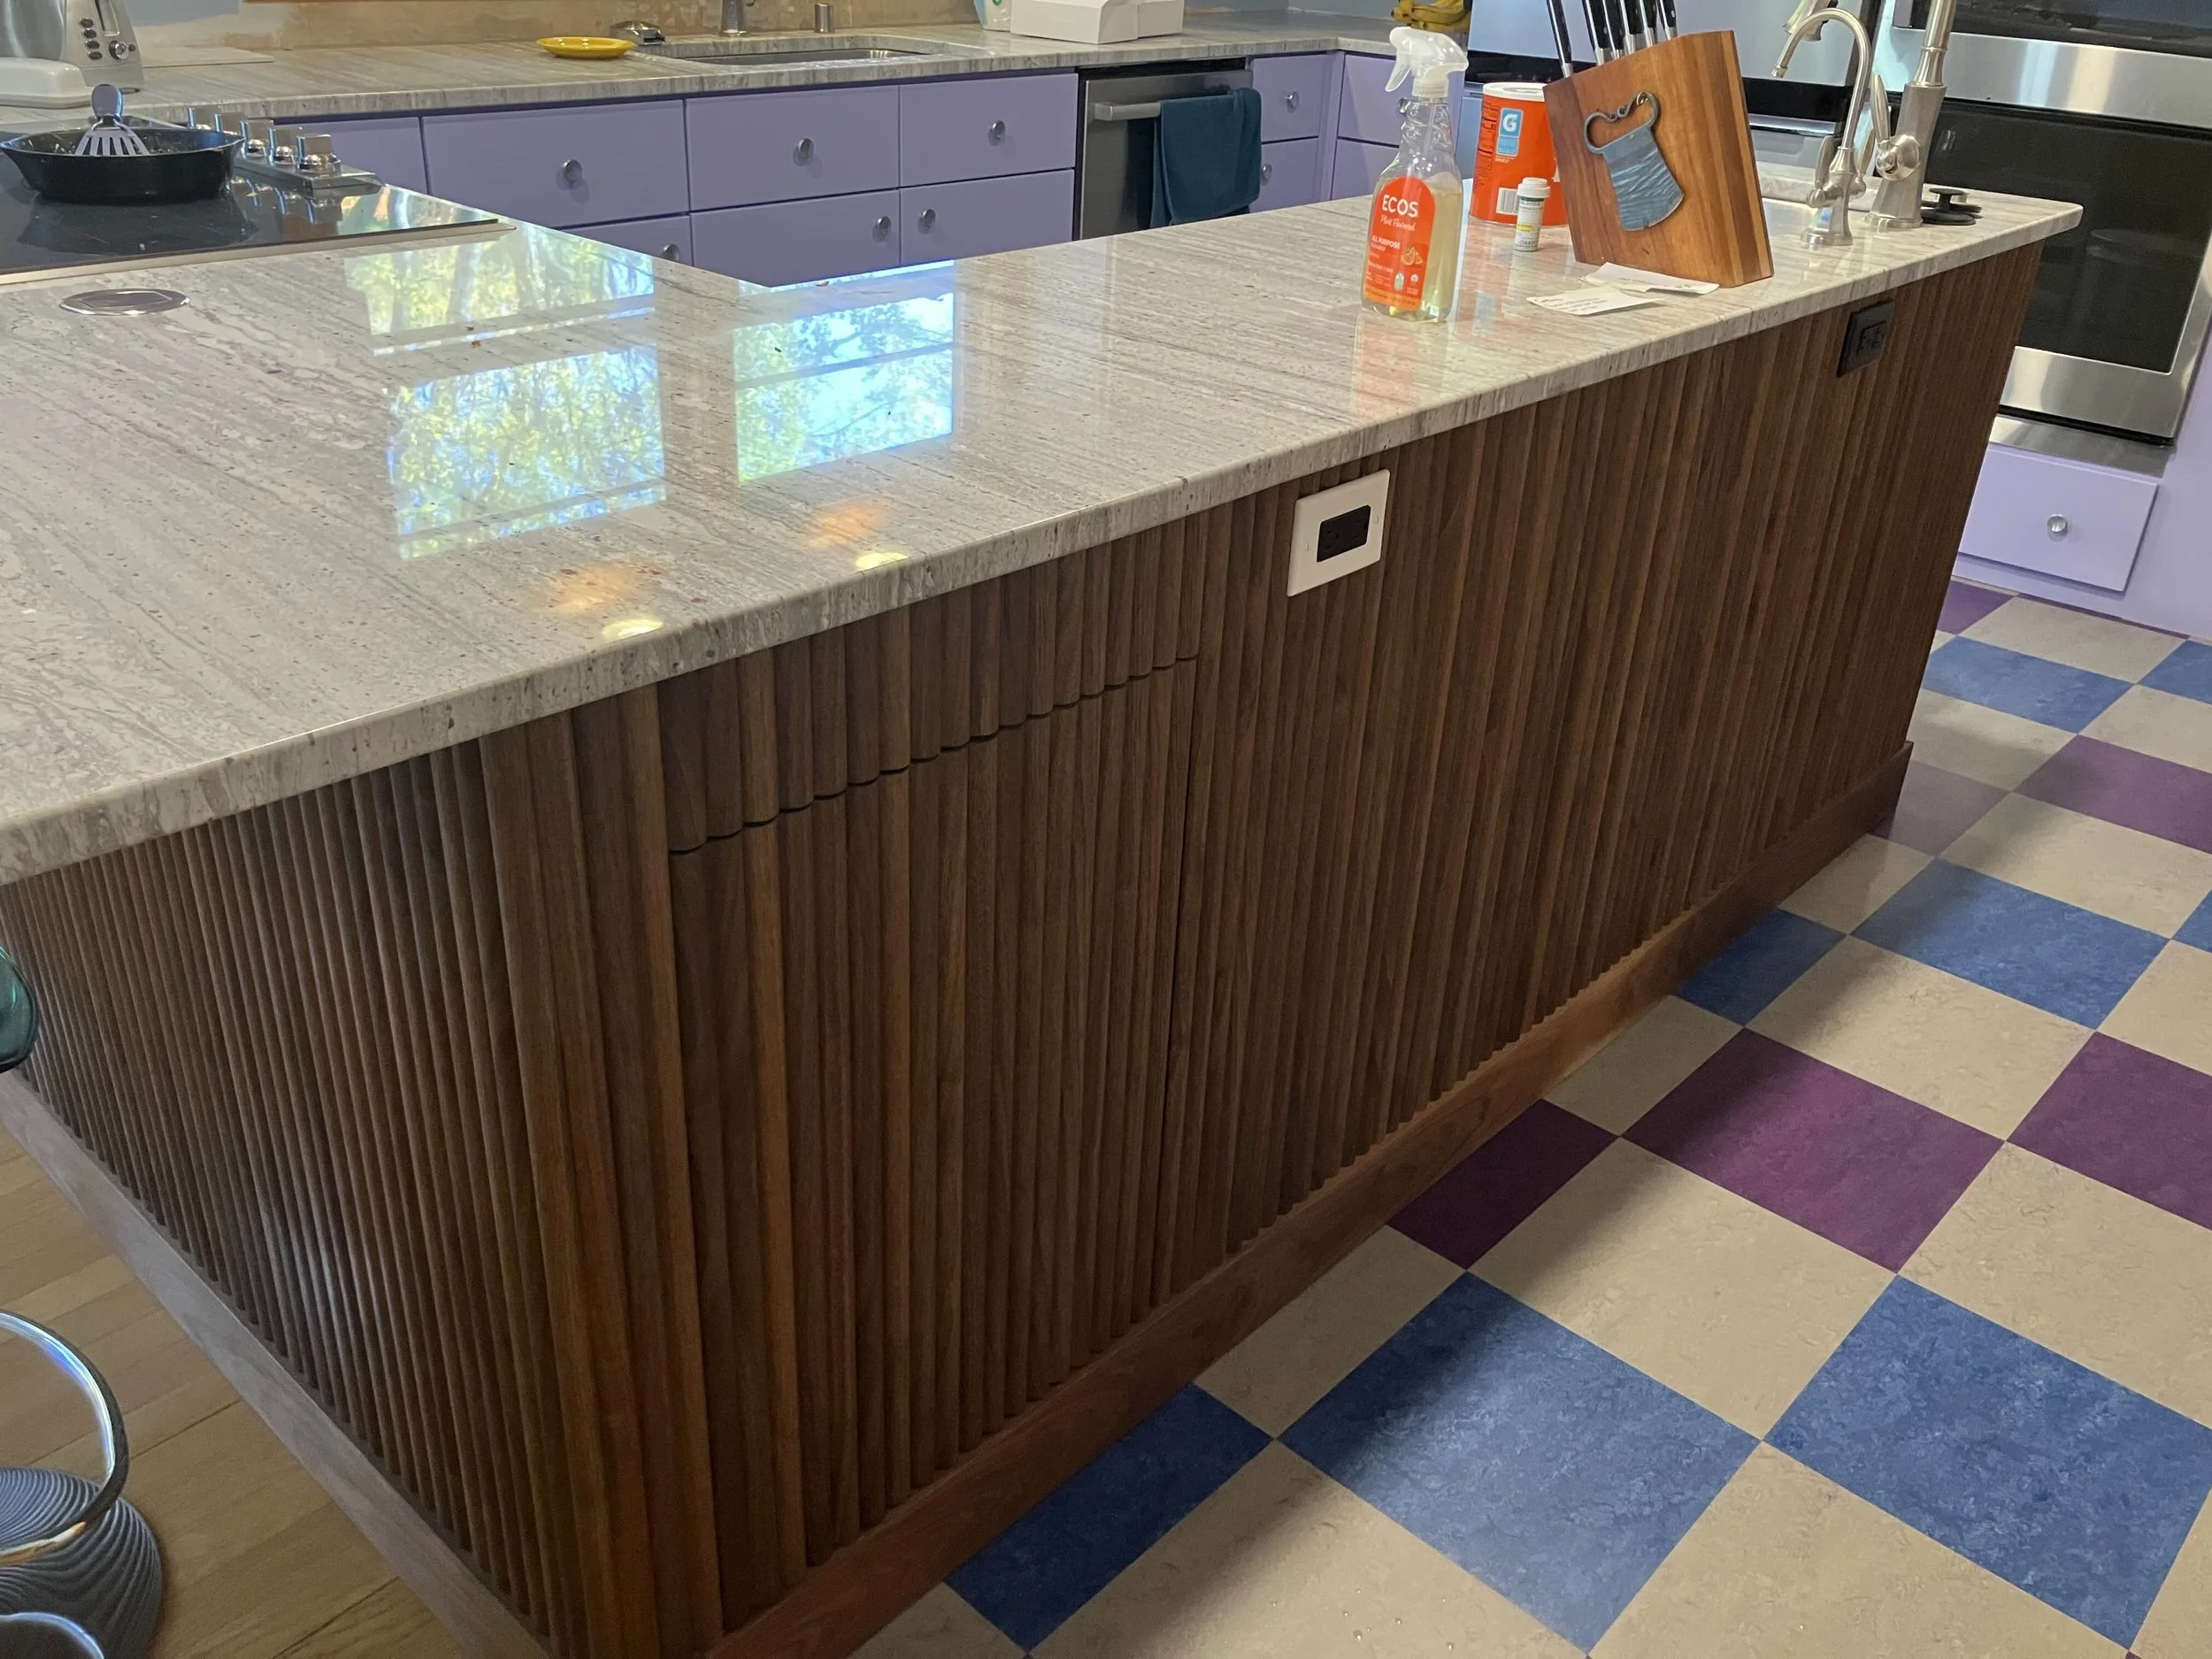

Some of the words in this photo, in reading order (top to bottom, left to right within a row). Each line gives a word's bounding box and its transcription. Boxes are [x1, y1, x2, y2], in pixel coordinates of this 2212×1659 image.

[1502, 113, 1518, 132] G
[1382, 194, 1419, 218] ECOS
[1379, 236, 1401, 250] PURPOSE
